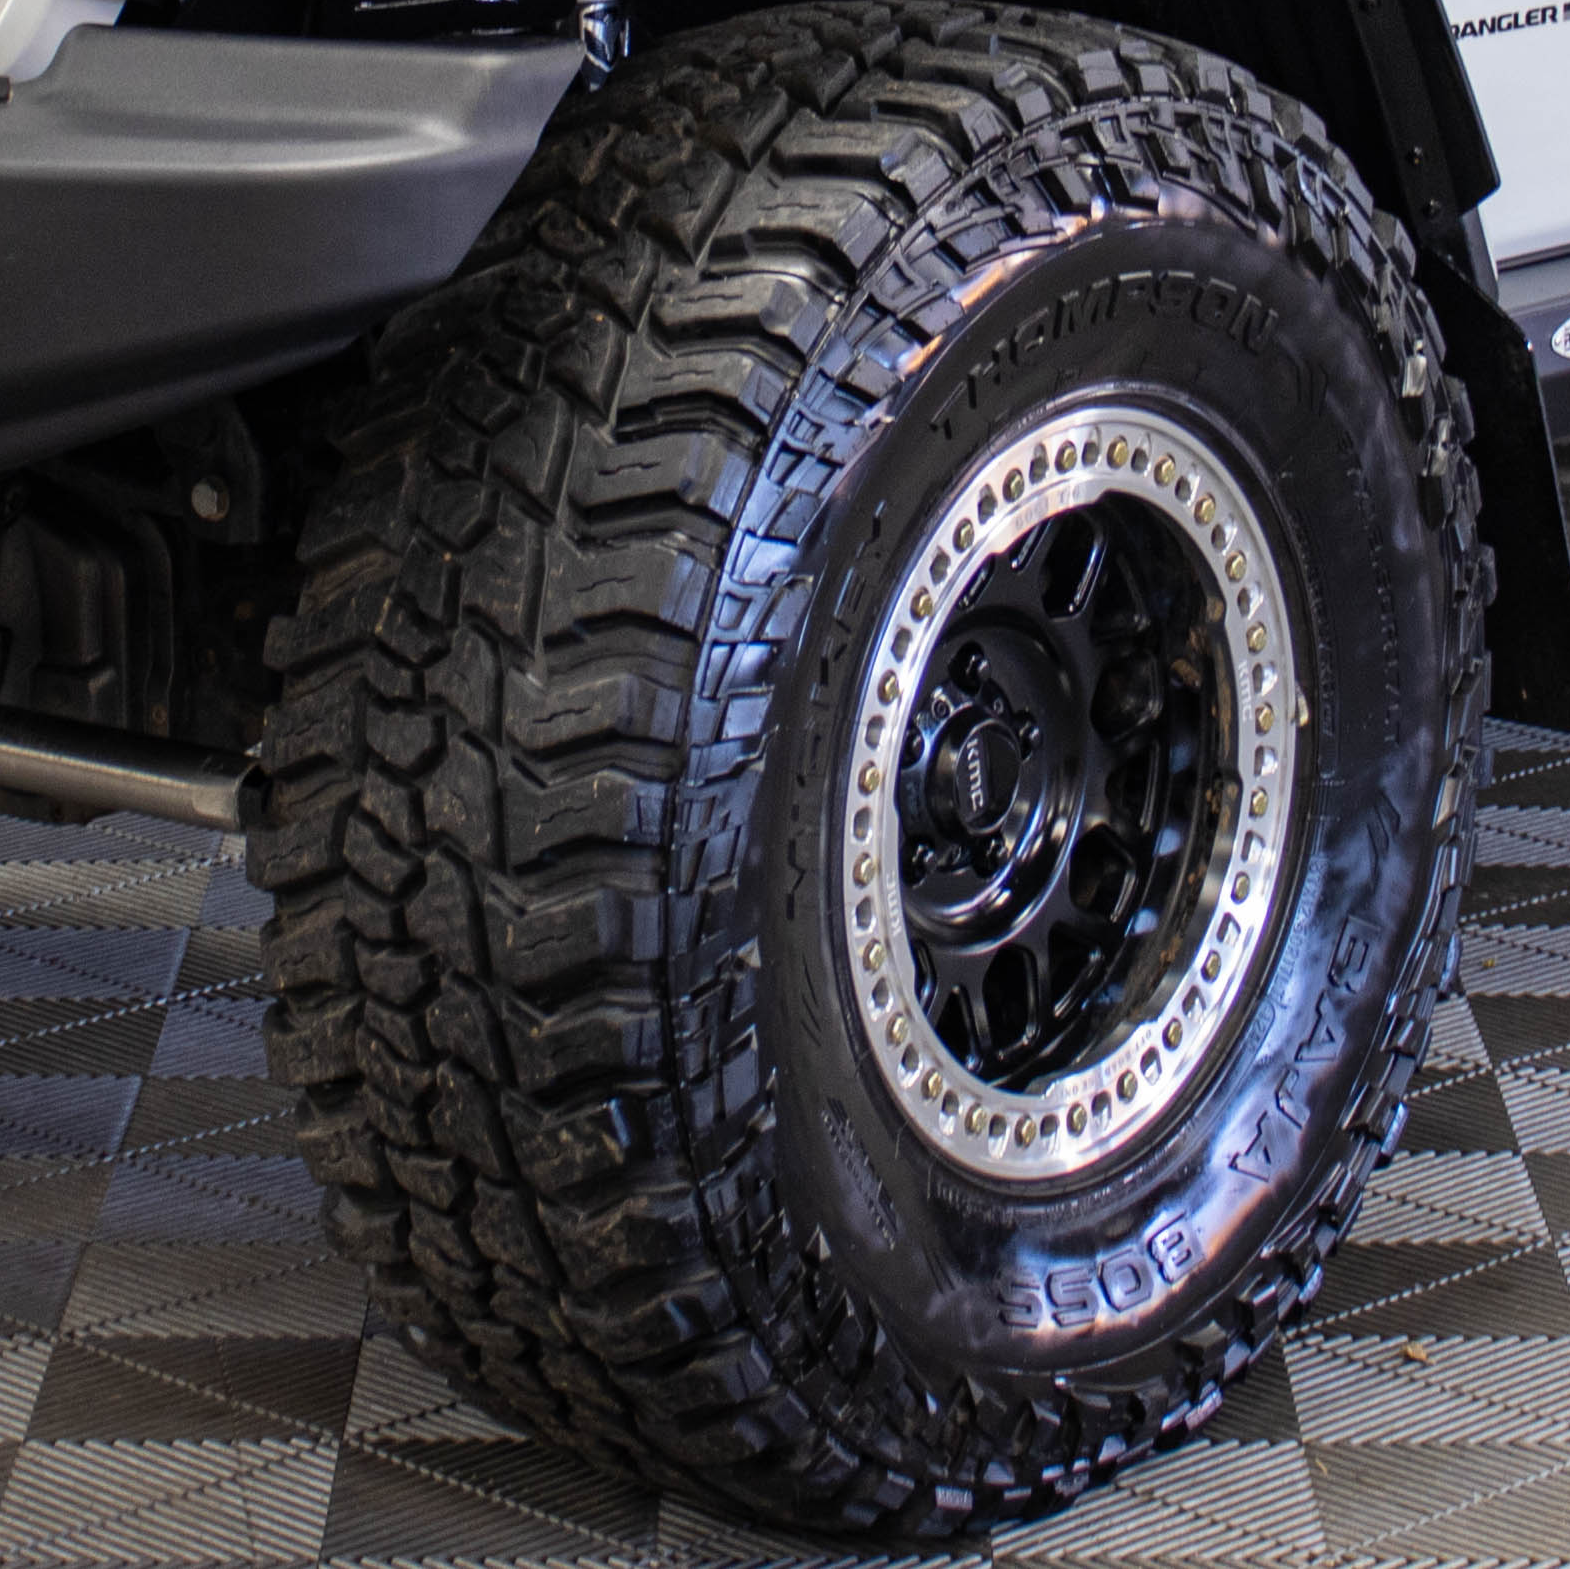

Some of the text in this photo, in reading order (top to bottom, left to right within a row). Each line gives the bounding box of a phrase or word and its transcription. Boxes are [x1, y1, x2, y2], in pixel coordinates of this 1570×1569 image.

[1449, 5, 1558, 41] RANGLER
[930, 268, 1280, 442] THOMPSON
[1228, 914, 1383, 1183] BAJA
[996, 1210, 1206, 1330] BOSS
